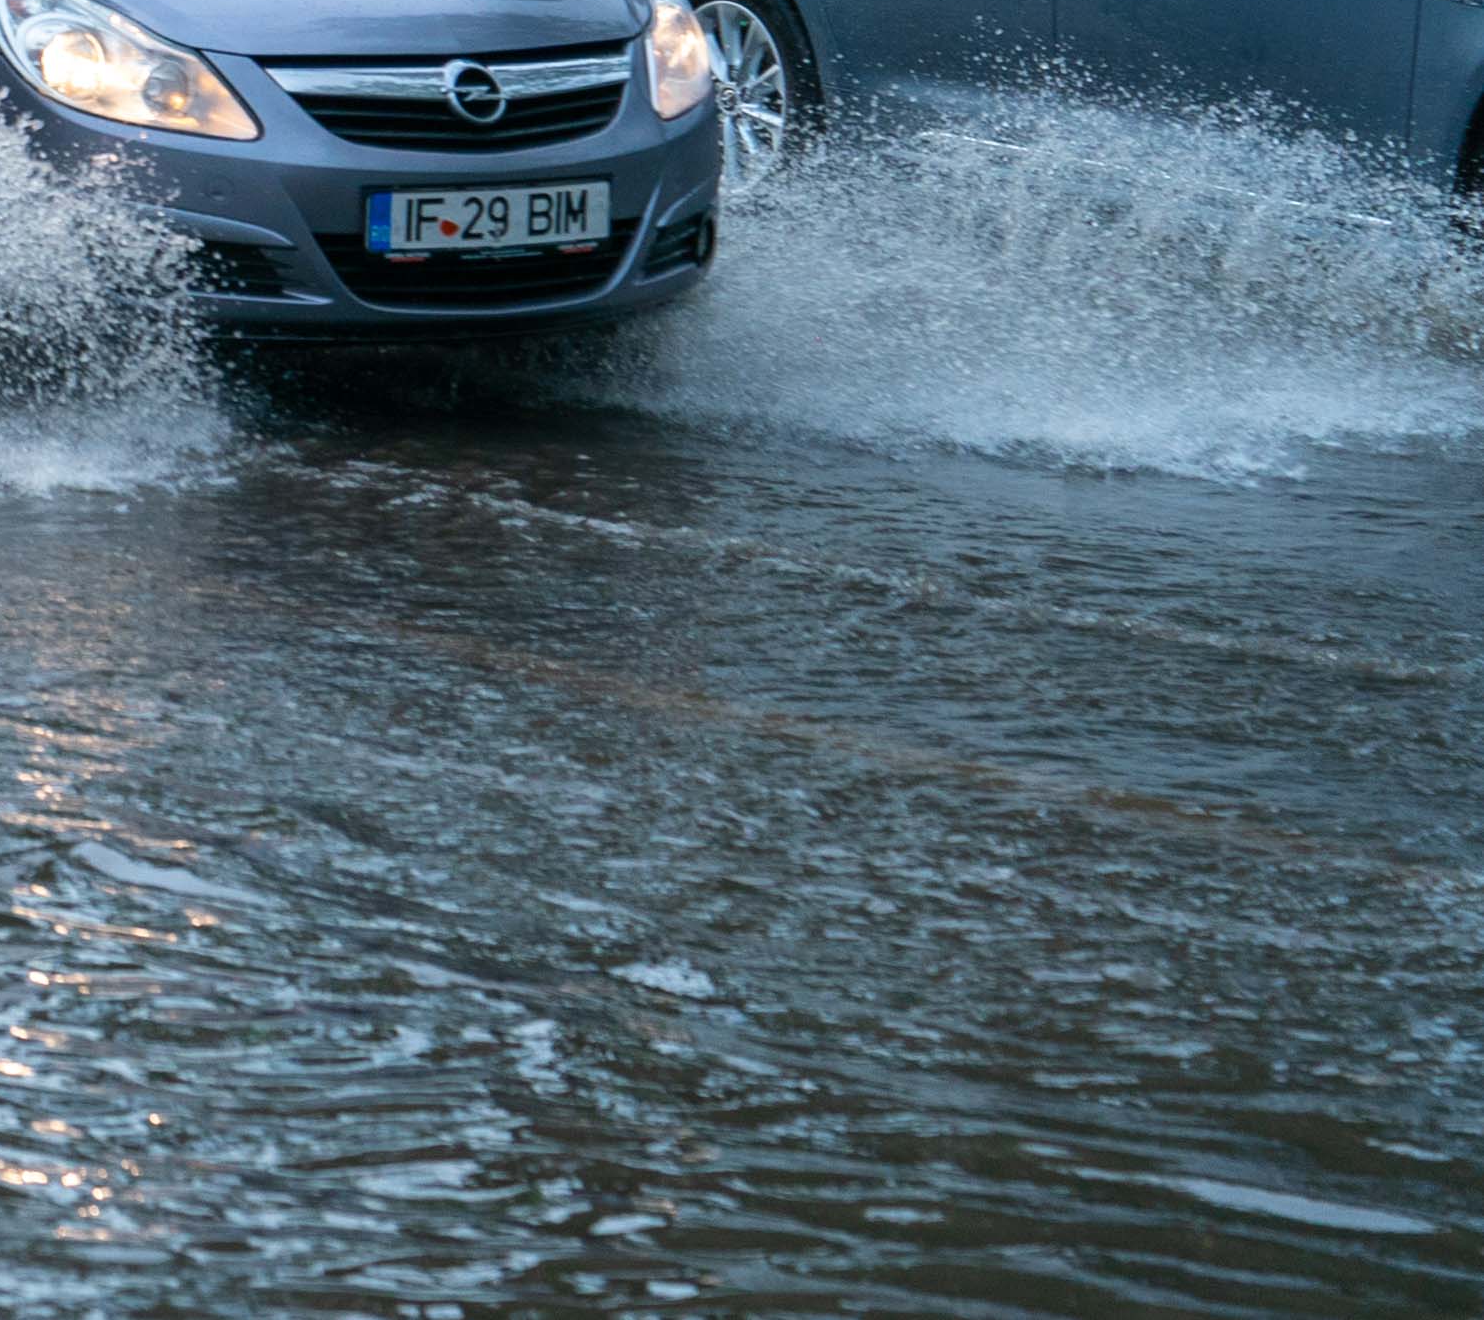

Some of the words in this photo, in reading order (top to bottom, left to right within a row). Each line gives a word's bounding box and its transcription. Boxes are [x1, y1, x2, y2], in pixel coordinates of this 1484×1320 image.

[406, 198, 445, 241] IF
[462, 196, 509, 239] 29
[528, 189, 588, 236] BIM
